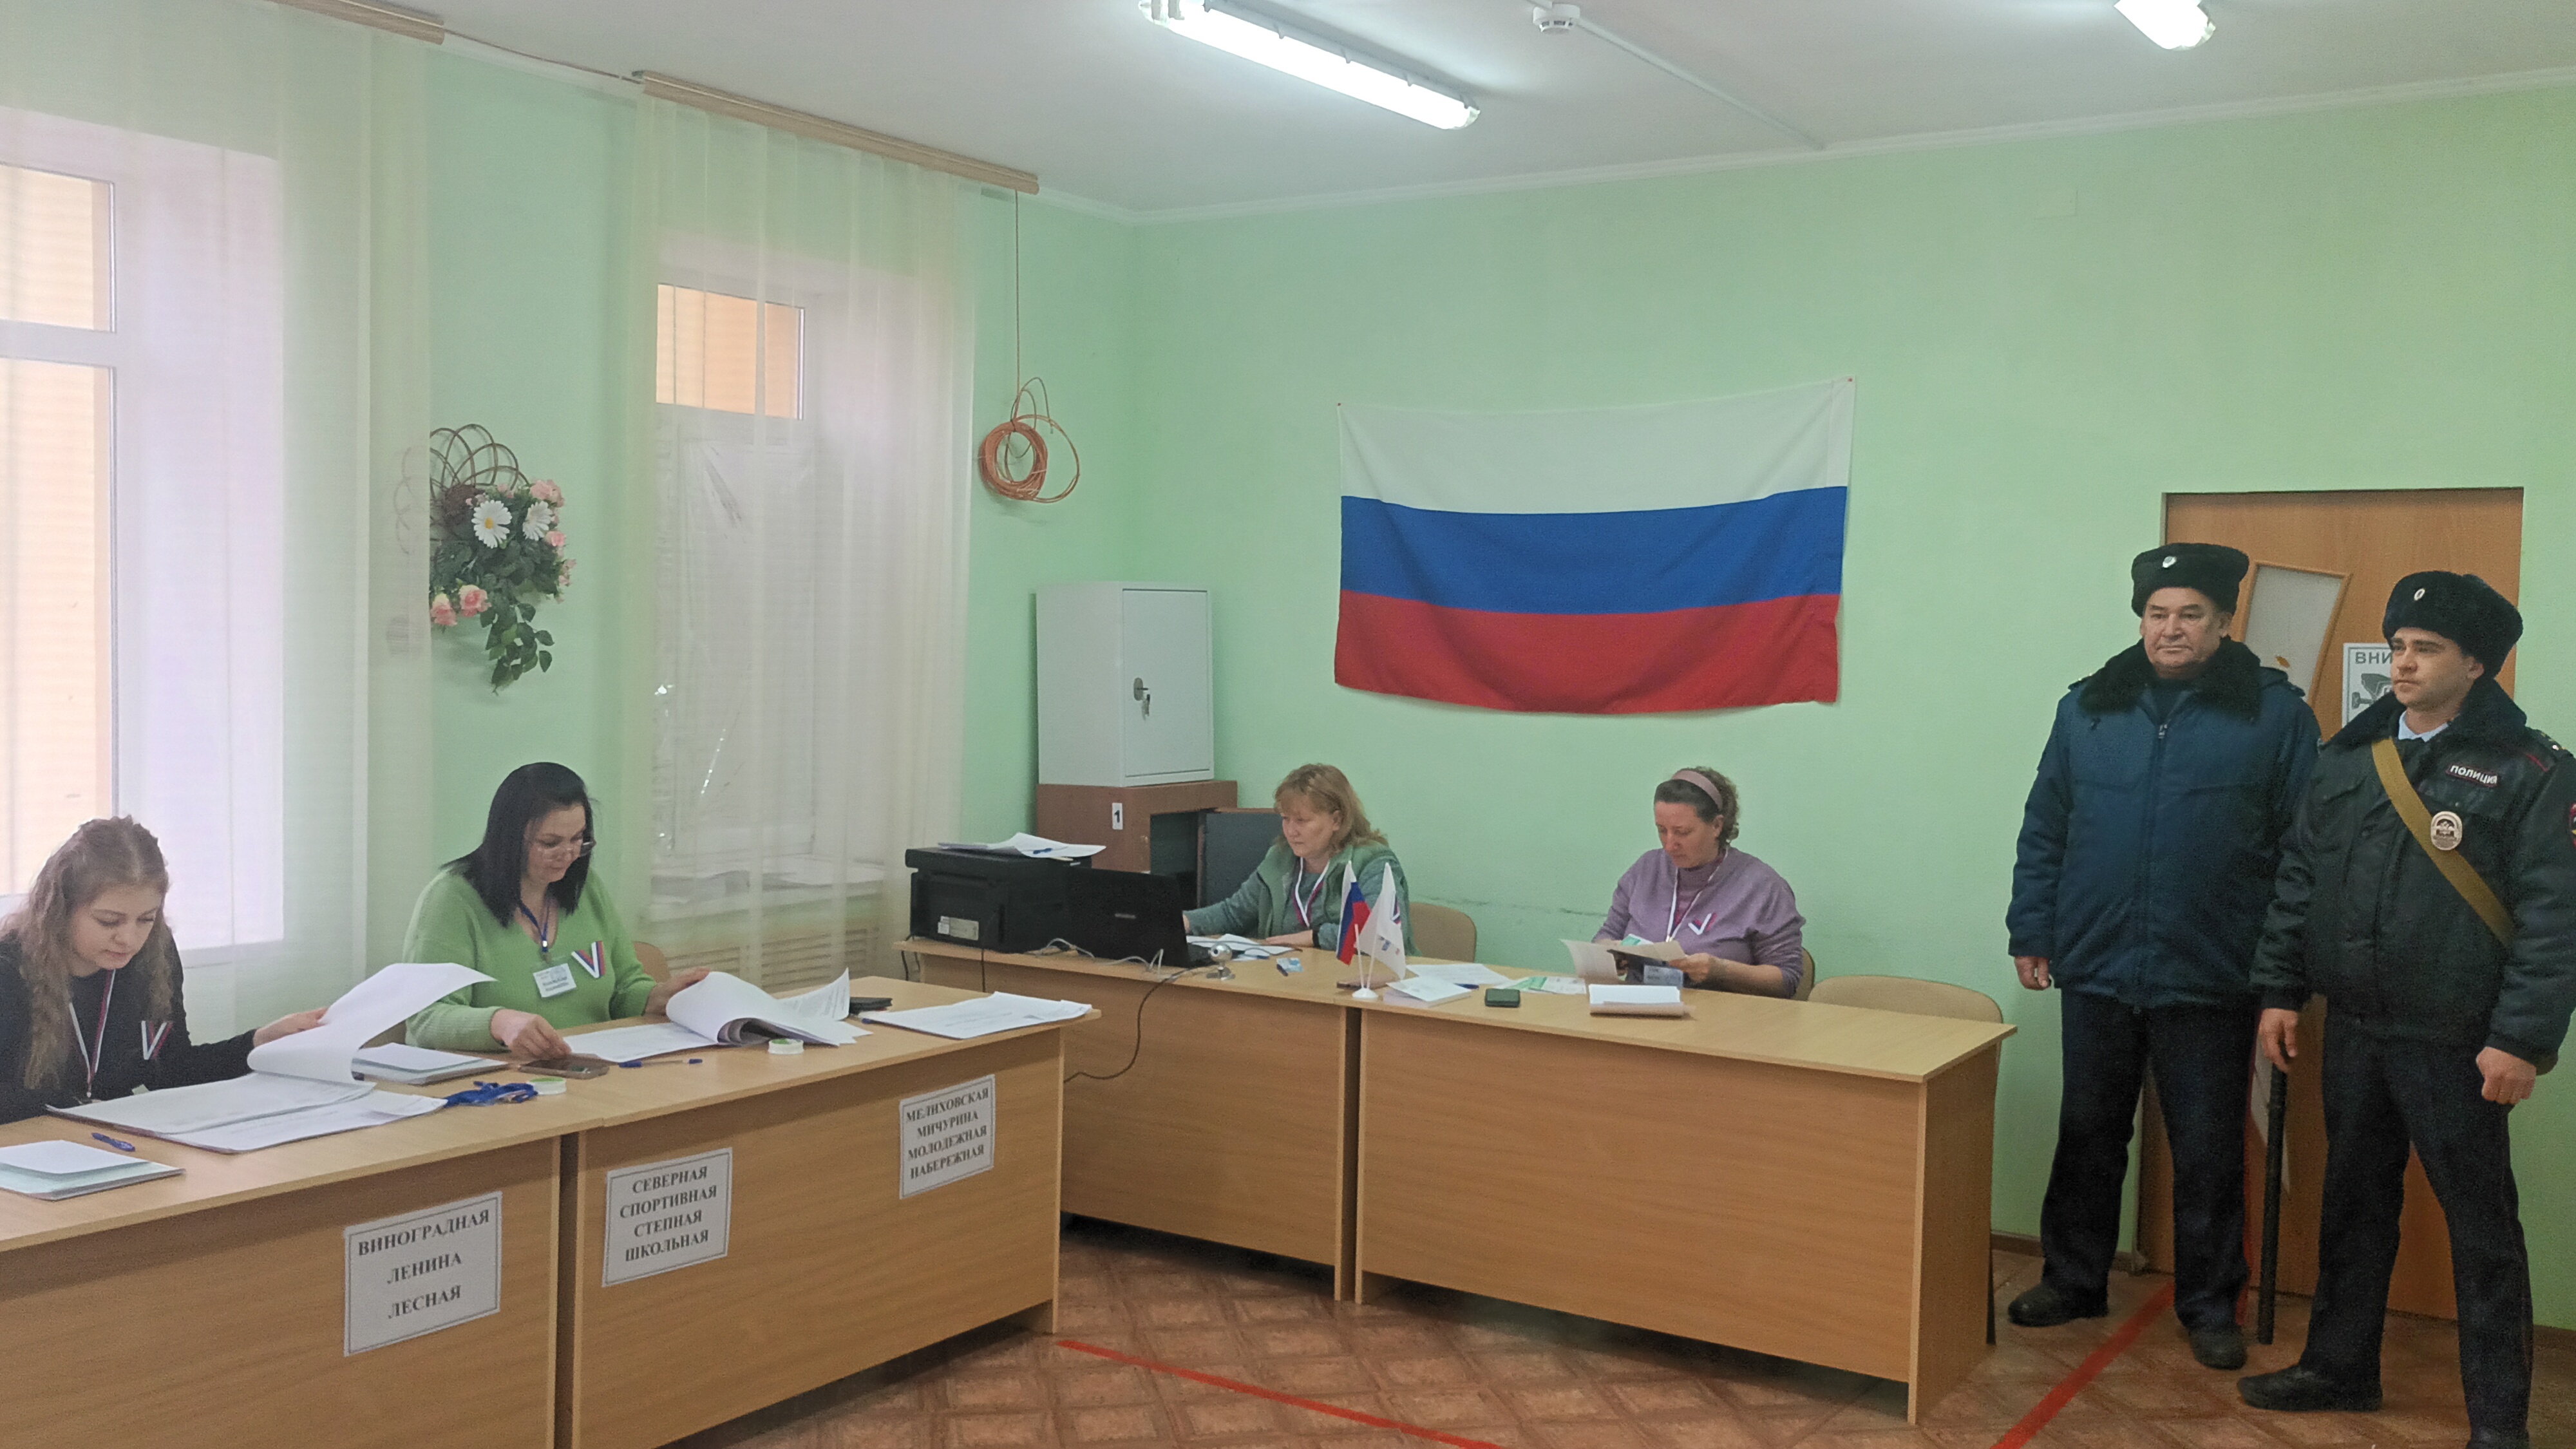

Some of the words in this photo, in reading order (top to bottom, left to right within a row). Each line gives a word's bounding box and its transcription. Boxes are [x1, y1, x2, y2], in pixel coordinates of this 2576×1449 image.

[2450, 765, 2497, 784] ПОЛИЦИЯ
[1114, 810, 1120, 823] 1
[906, 1088, 989, 1122] МЕЛИХОВСКАЯ
[917, 1110, 978, 1139] МИЧУРИНА
[907, 1125, 987, 1160] МОЛОДЕЖНАЯ
[910, 1144, 984, 1179] НАБЕРЕЖНАЯ
[632, 1166, 707, 1193] СЕВЕРНАЯ
[620, 1185, 717, 1218] СПОРТИВНАЯ
[359, 1209, 489, 1256] ВИНОГРАДНАЯ
[634, 1209, 702, 1237] СТЕПНАЯ
[625, 1229, 708, 1262] ШКОЛЬНАЯ
[387, 1253, 462, 1284] ЛЕНИНА
[388, 1285, 462, 1319] ЛЕСНАЯ
